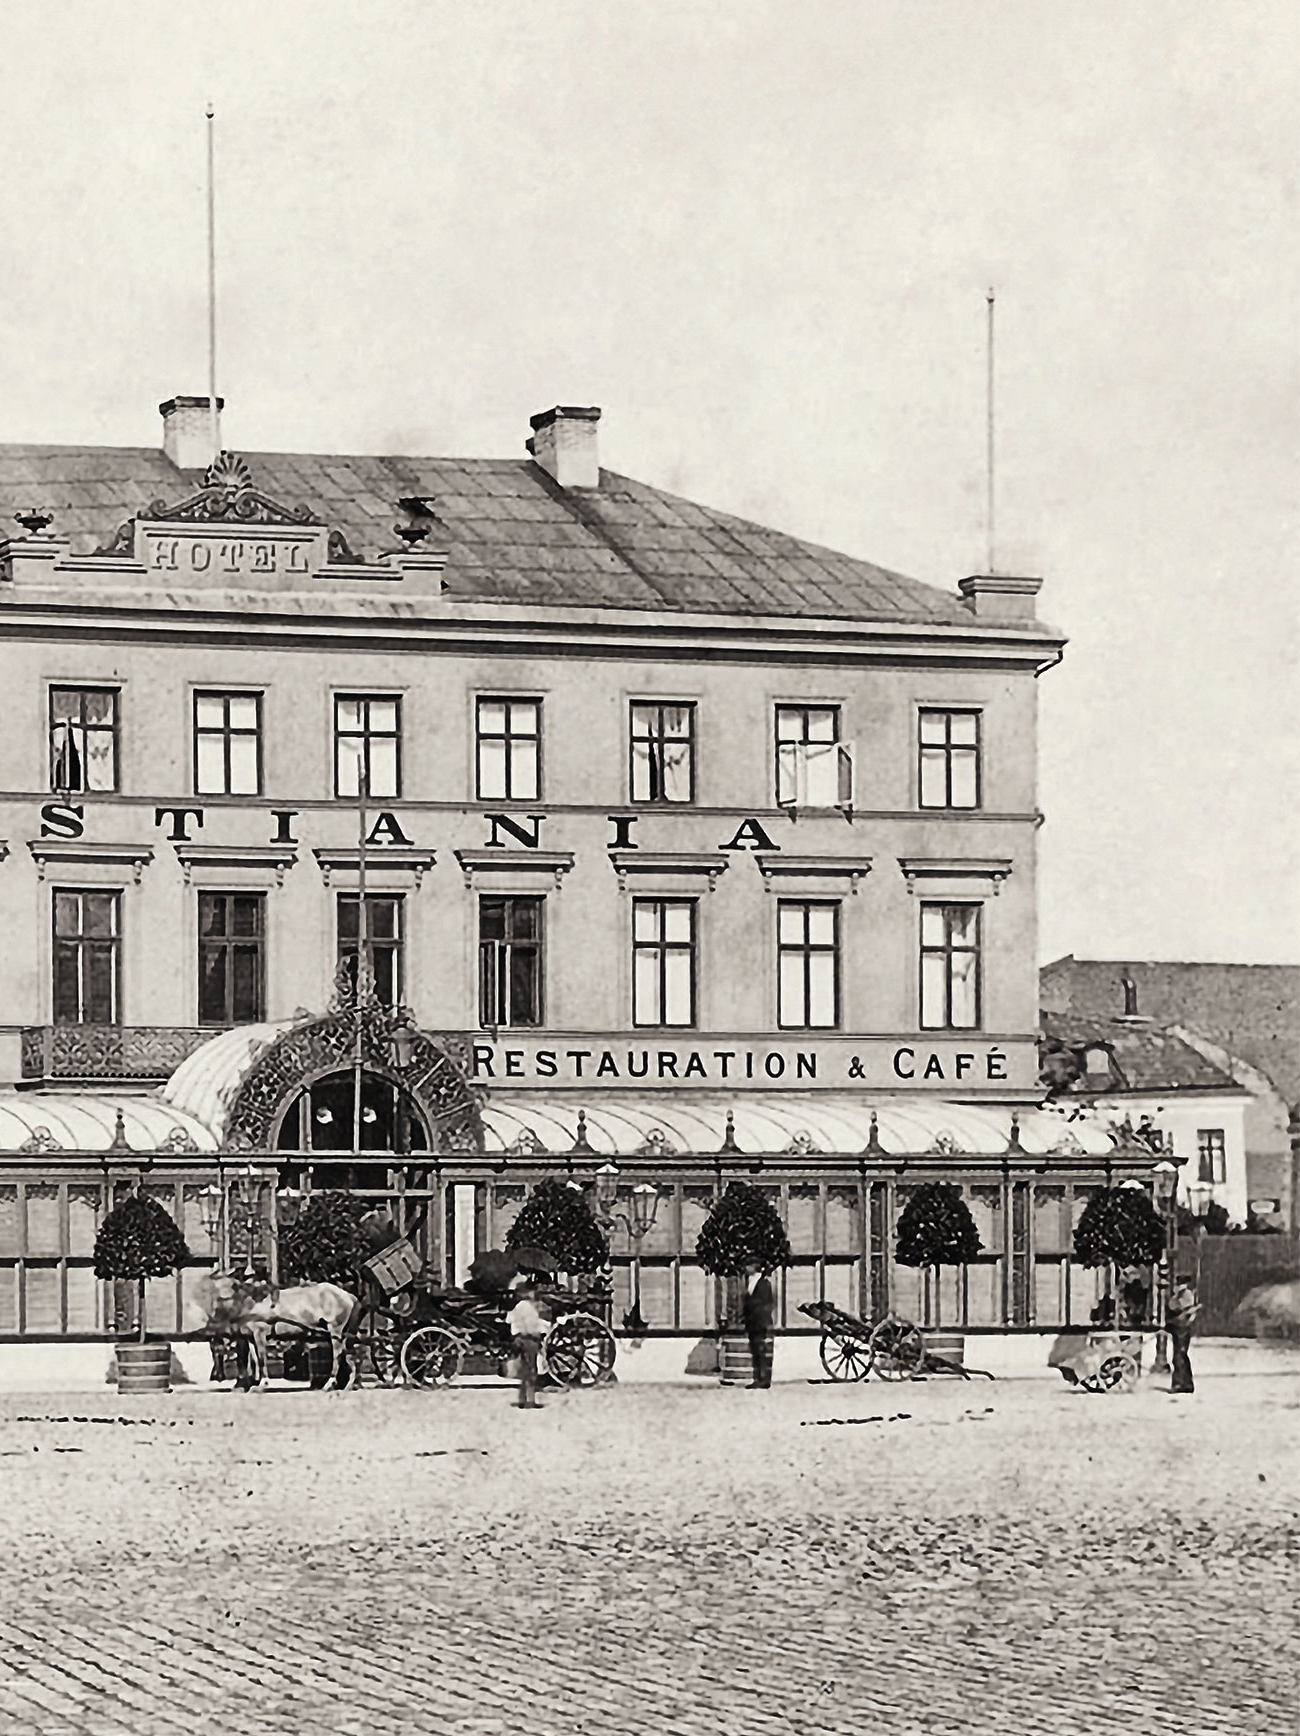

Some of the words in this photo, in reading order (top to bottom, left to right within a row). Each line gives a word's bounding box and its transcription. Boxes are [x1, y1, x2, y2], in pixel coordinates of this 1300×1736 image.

[151, 541, 309, 573] HOTEL
[471, 1045, 818, 1078] RESTAURATION
[848, 1056, 866, 1078] &
[893, 1046, 1008, 1080] CAFÉ
